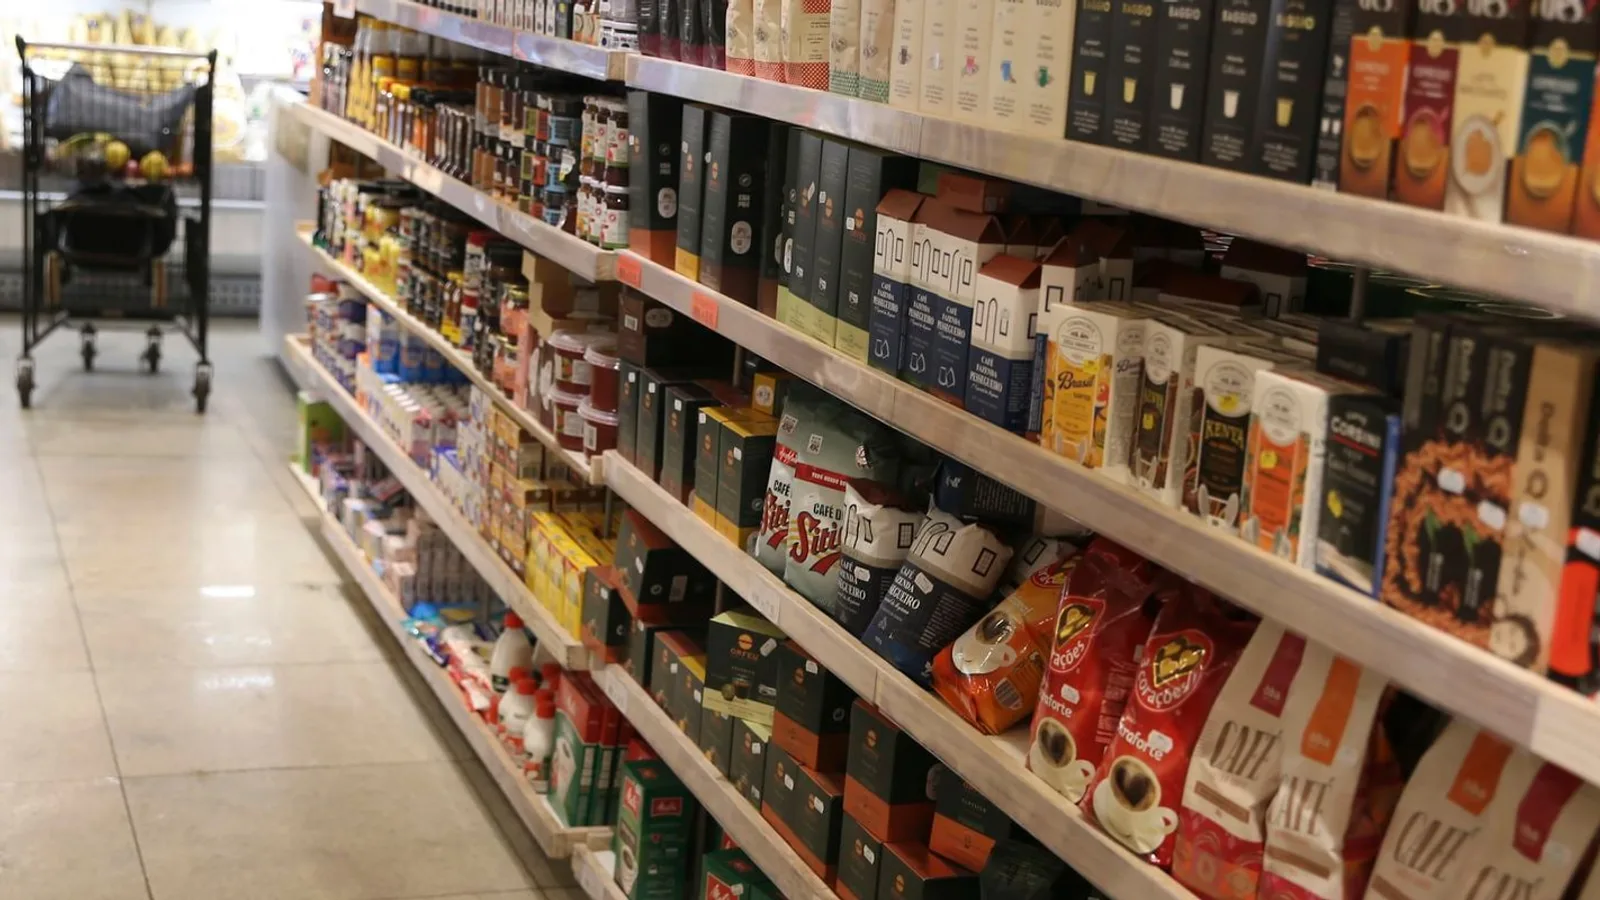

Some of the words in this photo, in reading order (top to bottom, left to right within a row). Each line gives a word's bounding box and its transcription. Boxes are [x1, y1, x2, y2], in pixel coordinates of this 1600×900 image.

[1057, 370, 1096, 391] Brasil
[773, 480, 790, 497] CAFÉ
[813, 502, 833, 518] CAFÉ
[1210, 720, 1284, 781] CAFÉ
[1393, 811, 1482, 882] CAFÉ
